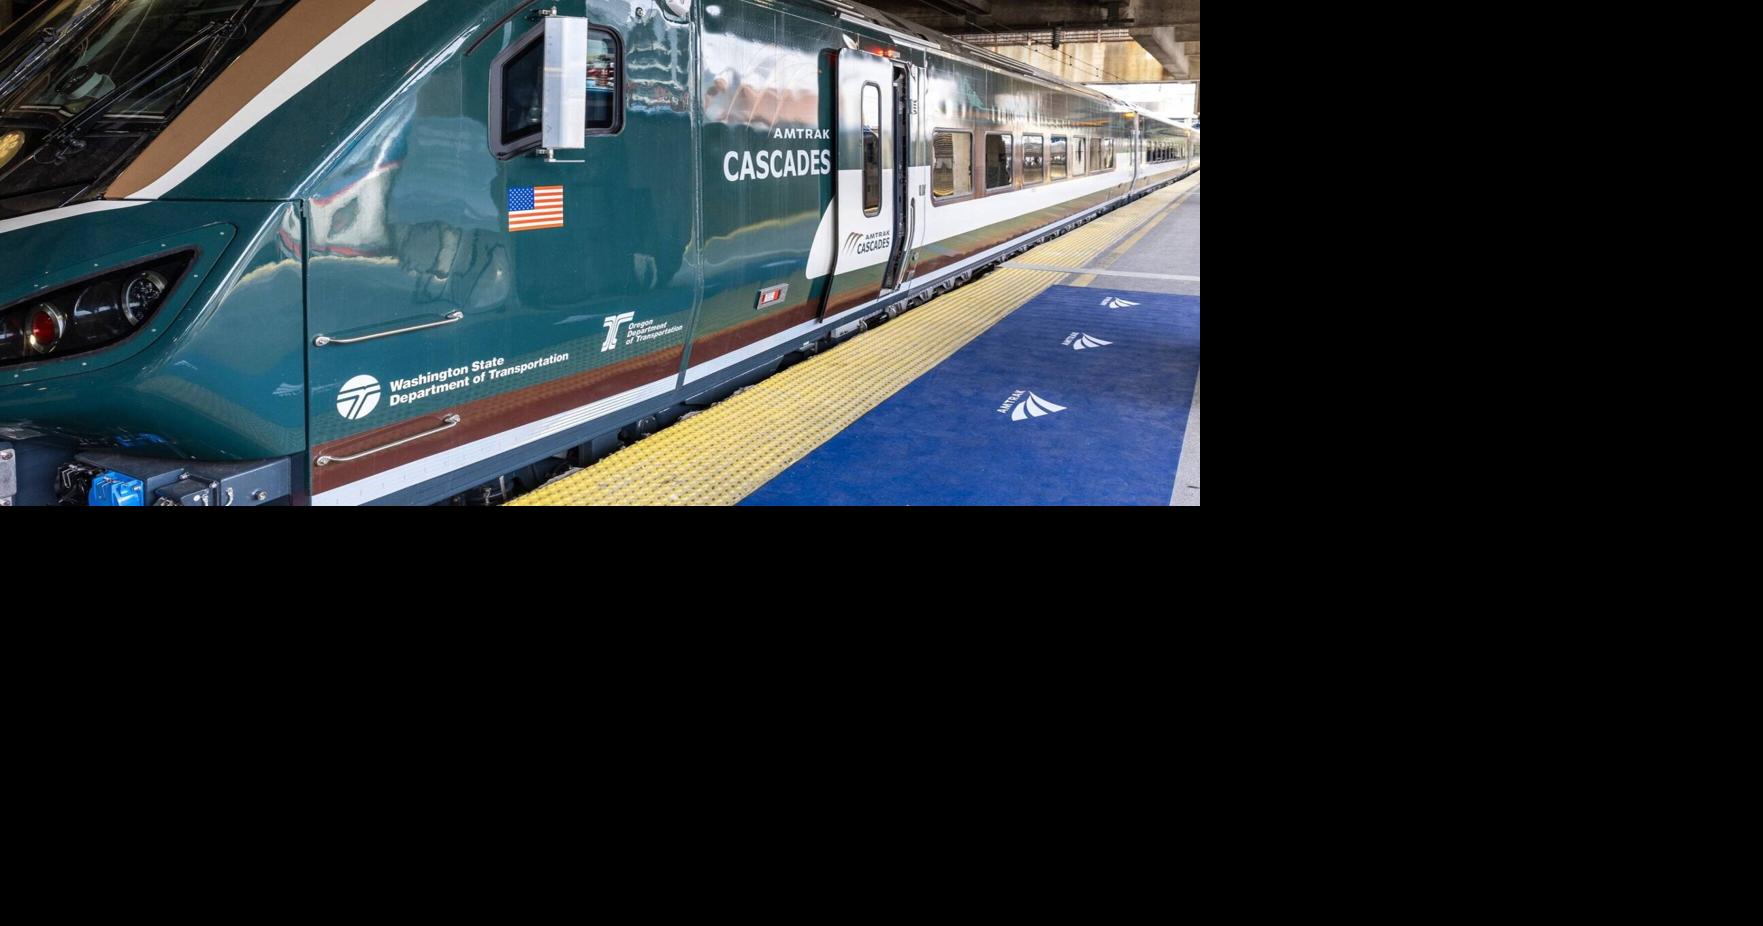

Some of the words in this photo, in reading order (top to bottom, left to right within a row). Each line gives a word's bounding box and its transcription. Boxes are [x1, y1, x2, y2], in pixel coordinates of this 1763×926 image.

[773, 128, 830, 139] AMTRAK
[723, 149, 831, 182] CASCADES
[865, 230, 890, 240] AMTRAK
[857, 237, 890, 254] CASCADES
[627, 322, 667, 338] Department
[628, 320, 653, 330] Oregon
[636, 325, 683, 342] Transportation
[389, 365, 469, 392] Washington
[471, 356, 504, 372] State
[389, 376, 470, 406] Department
[472, 371, 486, 384] of
[488, 352, 569, 380] Transportation
[996, 389, 1026, 413] AMTRAK
